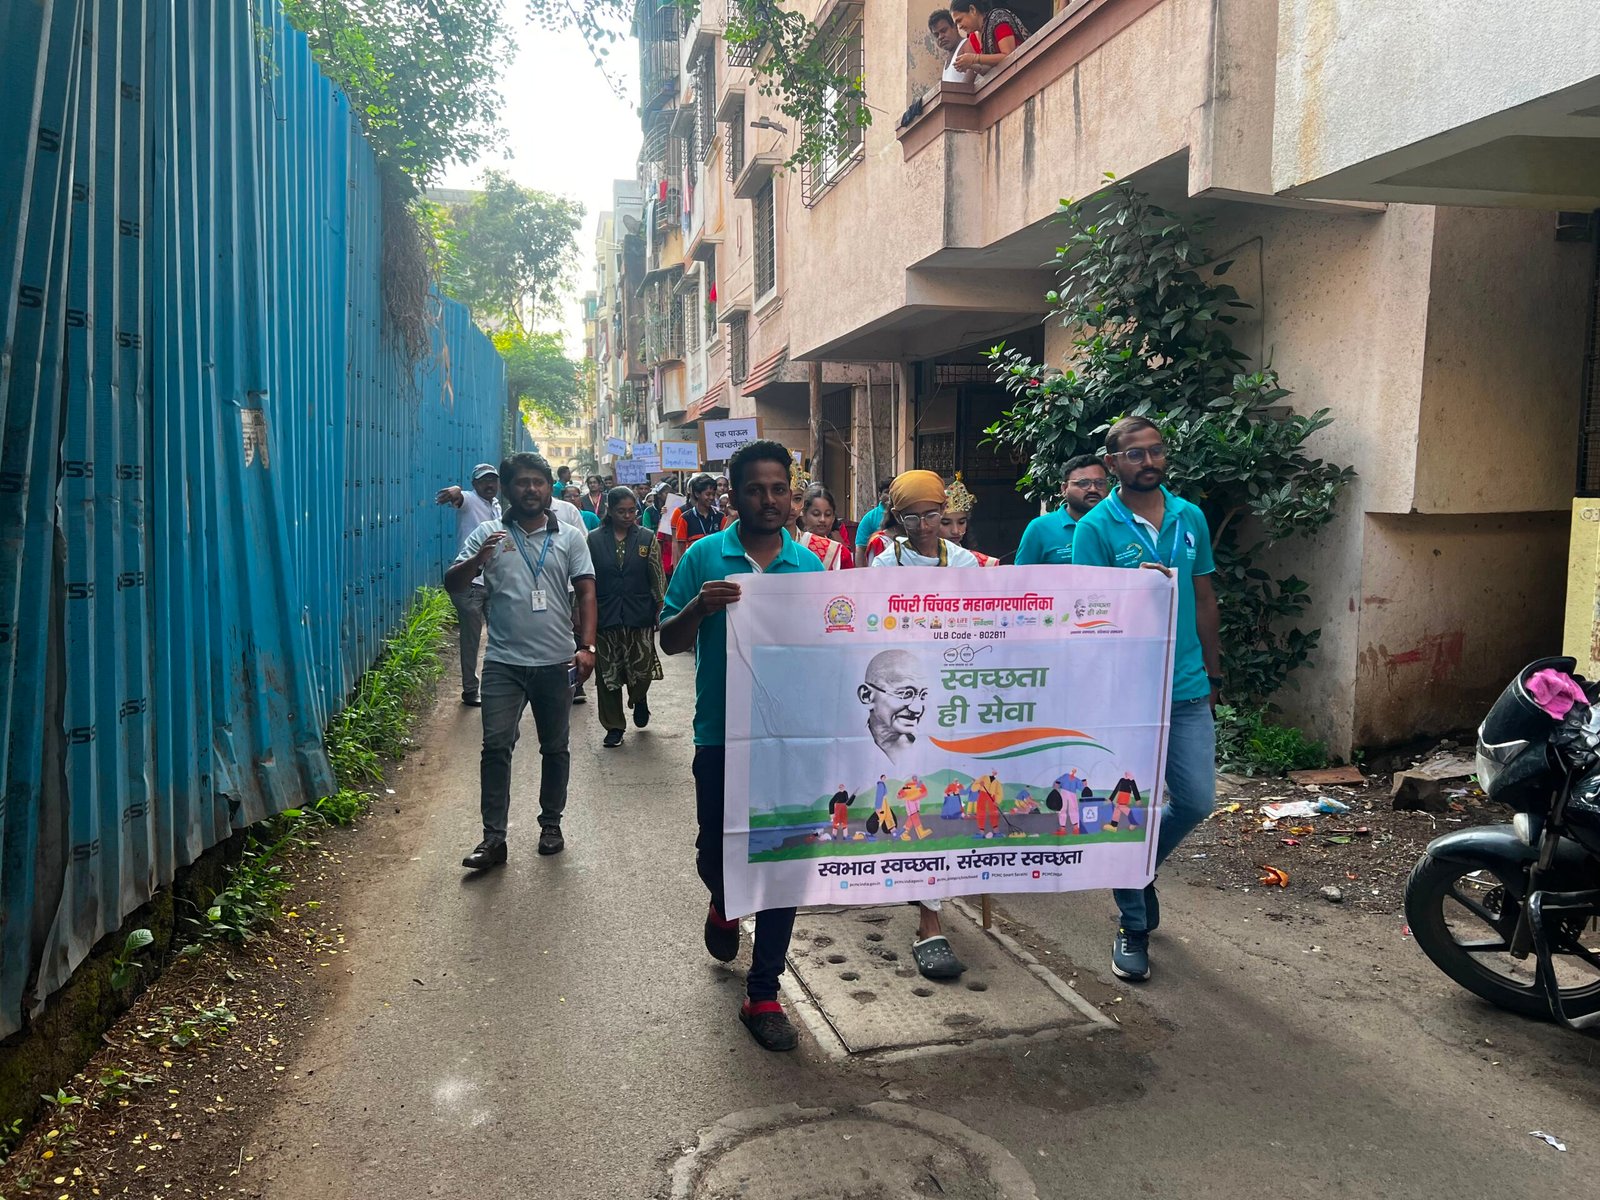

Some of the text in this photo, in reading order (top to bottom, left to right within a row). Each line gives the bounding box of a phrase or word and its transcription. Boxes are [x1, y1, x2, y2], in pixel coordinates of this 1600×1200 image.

[728, 429, 748, 437] पाऊल
[888, 593, 1054, 613] पिंपरी चिंचवड महानगरपालिका
[933, 631, 949, 640] ULB
[951, 631, 972, 640] Code
[979, 631, 1006, 639] 802811
[940, 667, 1049, 690] स्वच्छता
[937, 694, 1036, 727] ही सेवा
[818, 849, 1083, 877] स्वभाव स्वच्छता, संस्कार स्वच्छता
